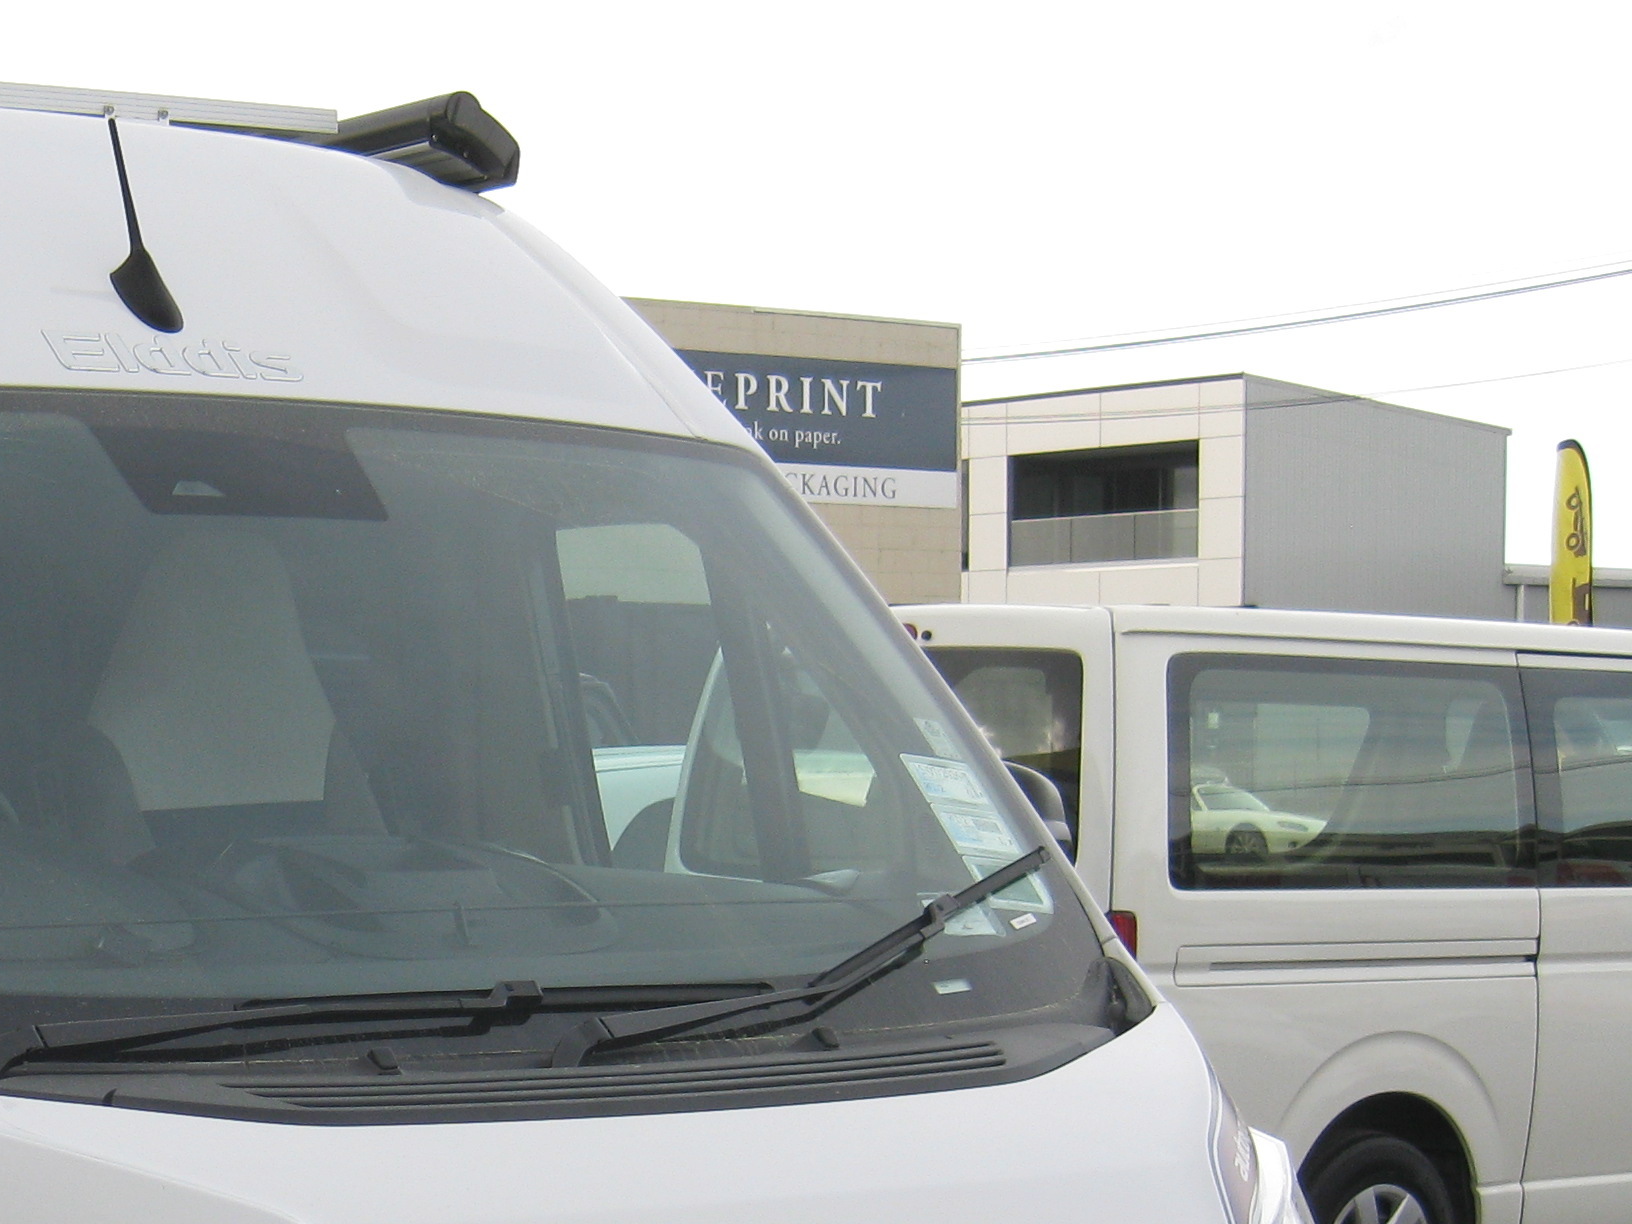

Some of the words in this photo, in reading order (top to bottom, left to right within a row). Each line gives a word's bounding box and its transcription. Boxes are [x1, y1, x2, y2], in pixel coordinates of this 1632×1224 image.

[41, 329, 305, 383] Elddis
[703, 370, 883, 419] EPRINT
[769, 428, 789, 442] on
[795, 429, 841, 449] paper.
